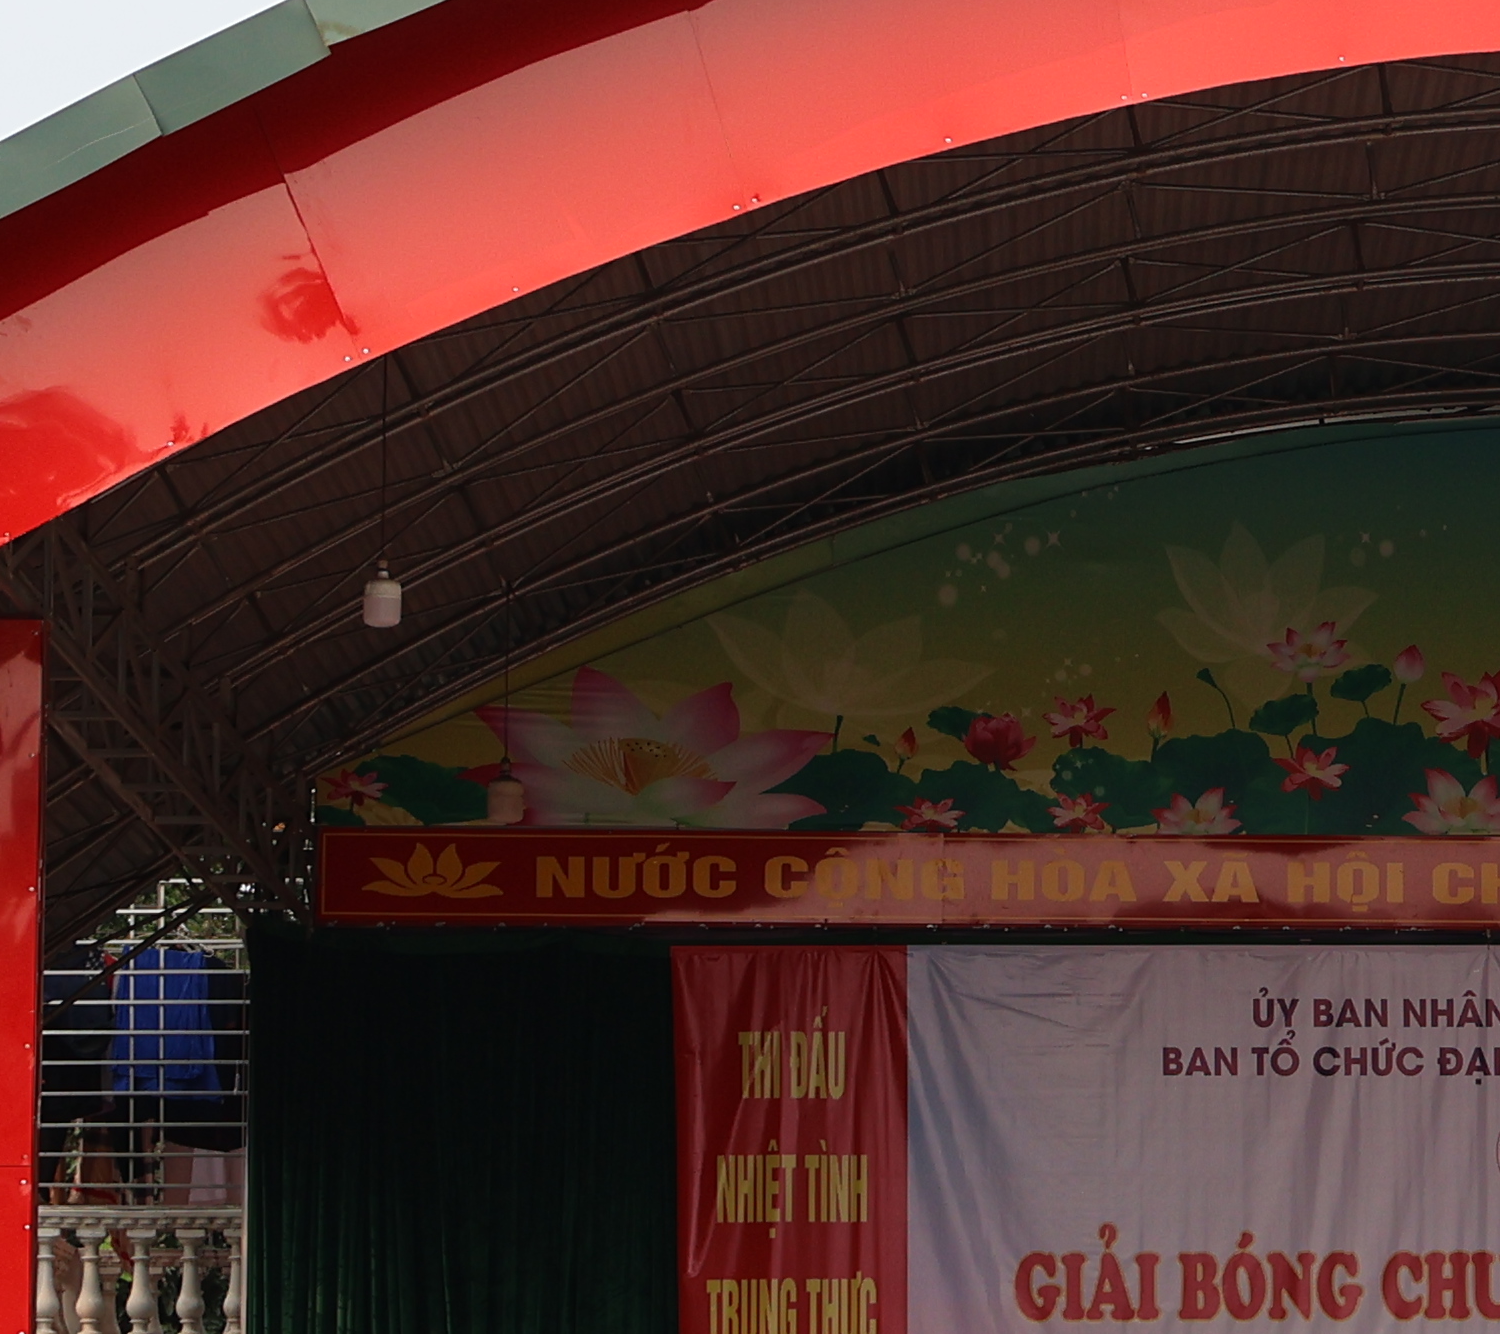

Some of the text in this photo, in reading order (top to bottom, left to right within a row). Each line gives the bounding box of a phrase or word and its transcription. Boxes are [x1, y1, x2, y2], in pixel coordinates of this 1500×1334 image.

[536, 843, 736, 899] NƯỚC
[764, 848, 966, 908] CỘNG
[992, 847, 1137, 902] HÒA
[1163, 850, 1259, 903] XÃ
[1286, 851, 1403, 912] HỘI
[1252, 987, 1300, 1028] ỦY
[1313, 998, 1388, 1028] BAN
[738, 1006, 845, 1100] THI ĐẤU
[1162, 1047, 1238, 1076] BAN
[1252, 1030, 1300, 1076] TỔ
[1313, 1038, 1424, 1076] CHỨC
[717, 1139, 867, 1238] NHIỆT TÌNH
[1014, 1222, 1162, 1322] GIẢI
[1177, 1231, 1364, 1322] BÓNG
